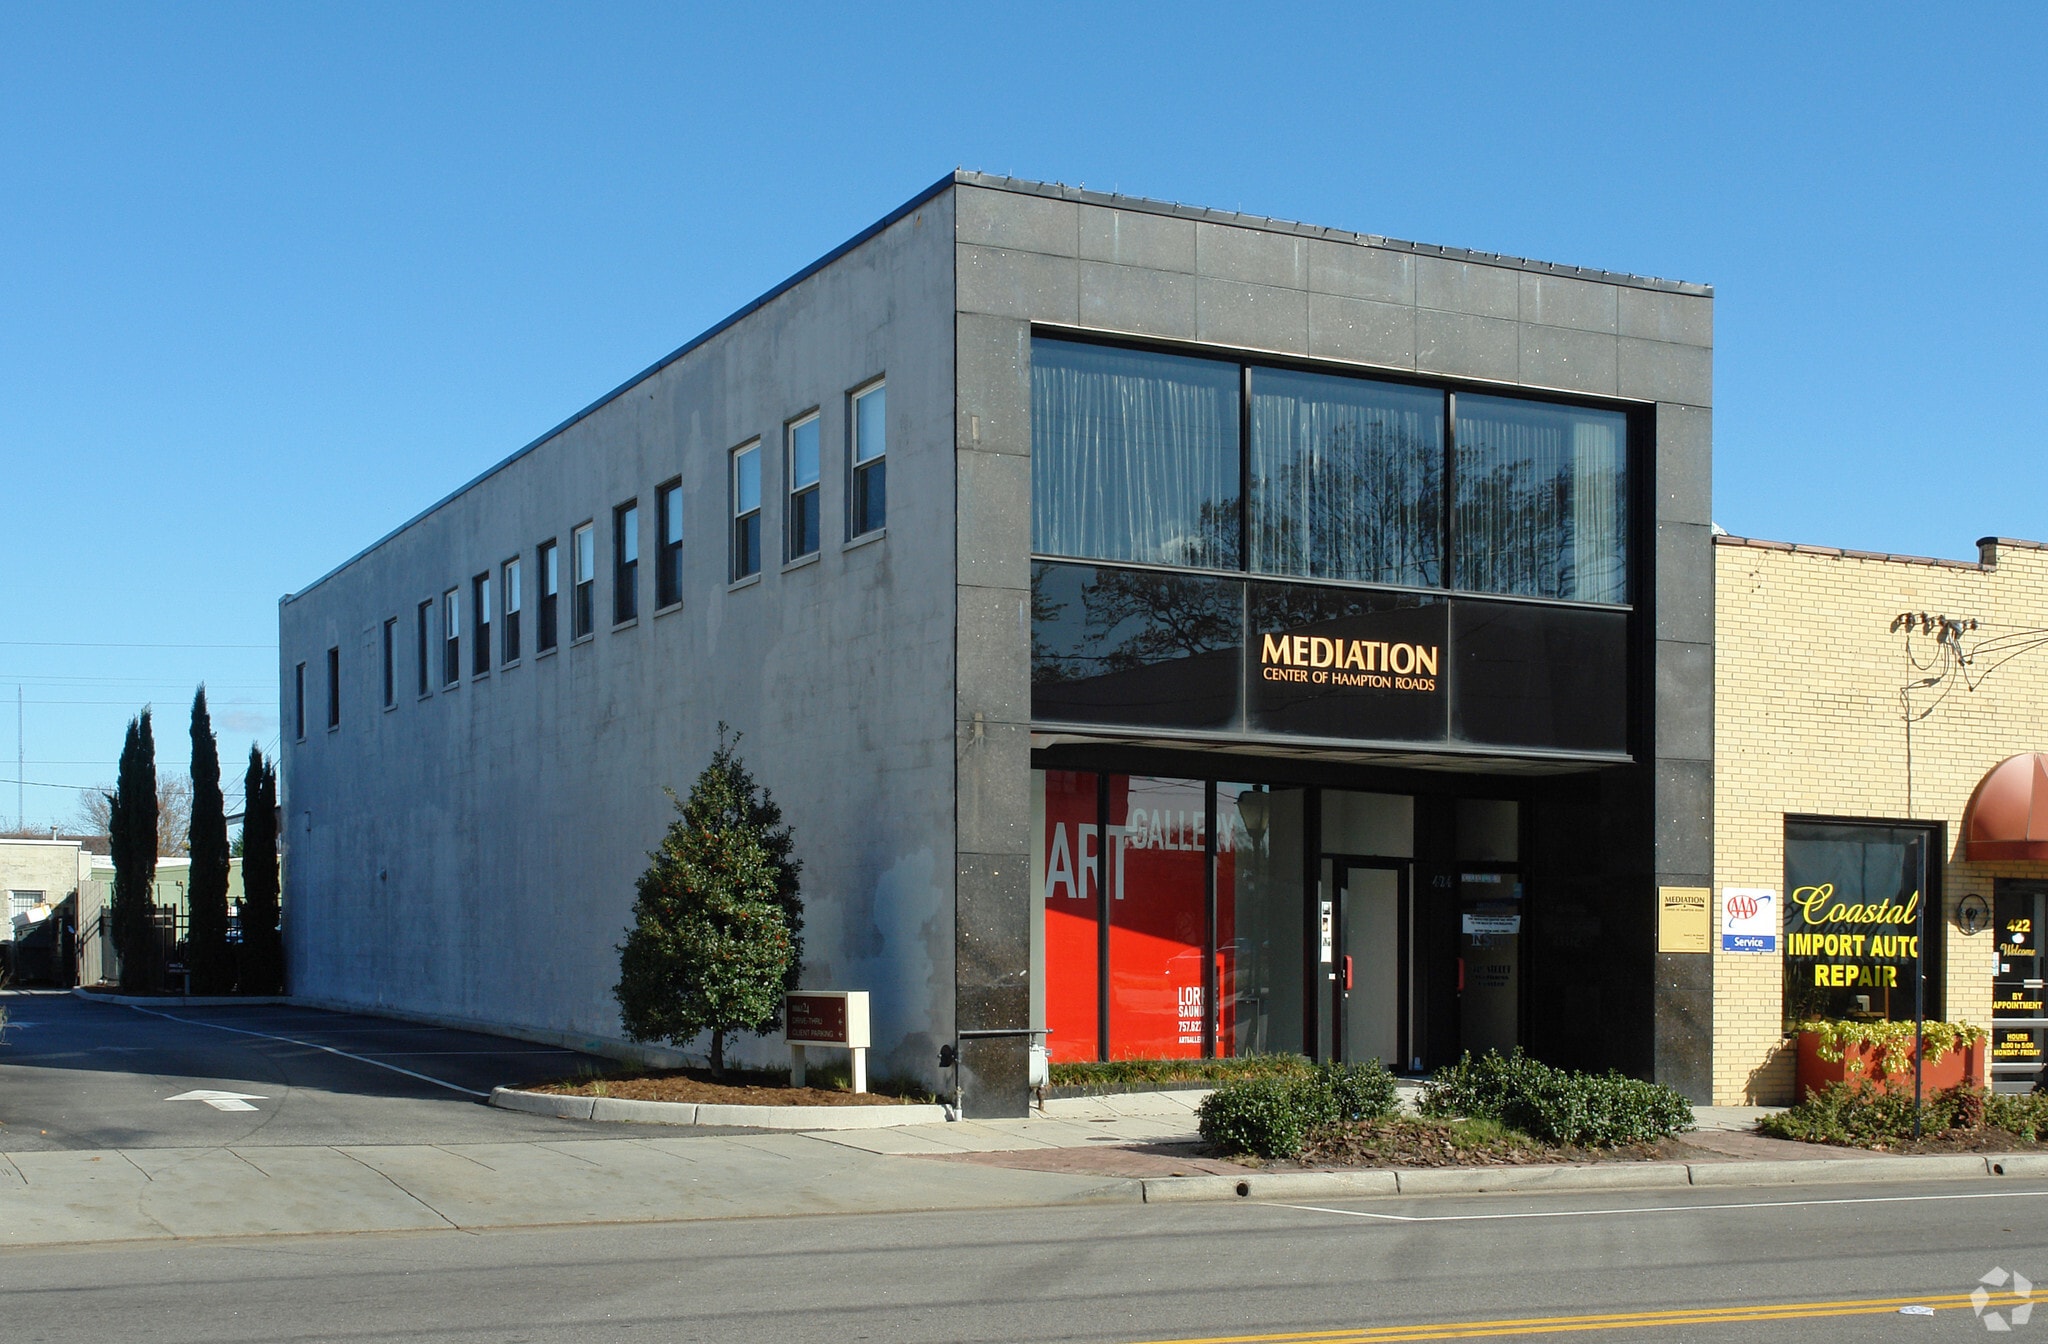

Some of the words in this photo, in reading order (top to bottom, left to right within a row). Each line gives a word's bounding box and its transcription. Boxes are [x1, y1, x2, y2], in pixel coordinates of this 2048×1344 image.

[1261, 633, 1438, 676] MEDIATION
[1263, 667, 1308, 682] CENTER
[1312, 670, 1328, 683] OF
[1332, 672, 1392, 688] HAMPTON
[1395, 676, 1435, 691] ROADS
[1045, 821, 1137, 900] ART
[1131, 807, 1236, 853] GALLEY
[1664, 895, 1705, 904] MEDIATION
[1792, 883, 1919, 925] Coastal
[1730, 896, 1756, 919] AAA
[2007, 919, 2031, 932] 422
[1734, 936, 1764, 947] Service
[1788, 933, 1866, 957] IMPORT
[2000, 943, 2036, 956] Welcome
[1814, 964, 1898, 987] REPAIR
[2012, 992, 2023, 1001] BY
[1993, 1001, 2043, 1010] APPOINTMENT
[792, 1028, 810, 1037] CLIENT
[811, 1029, 834, 1038] PARKING
[2006, 1033, 2028, 1041] HOURS
